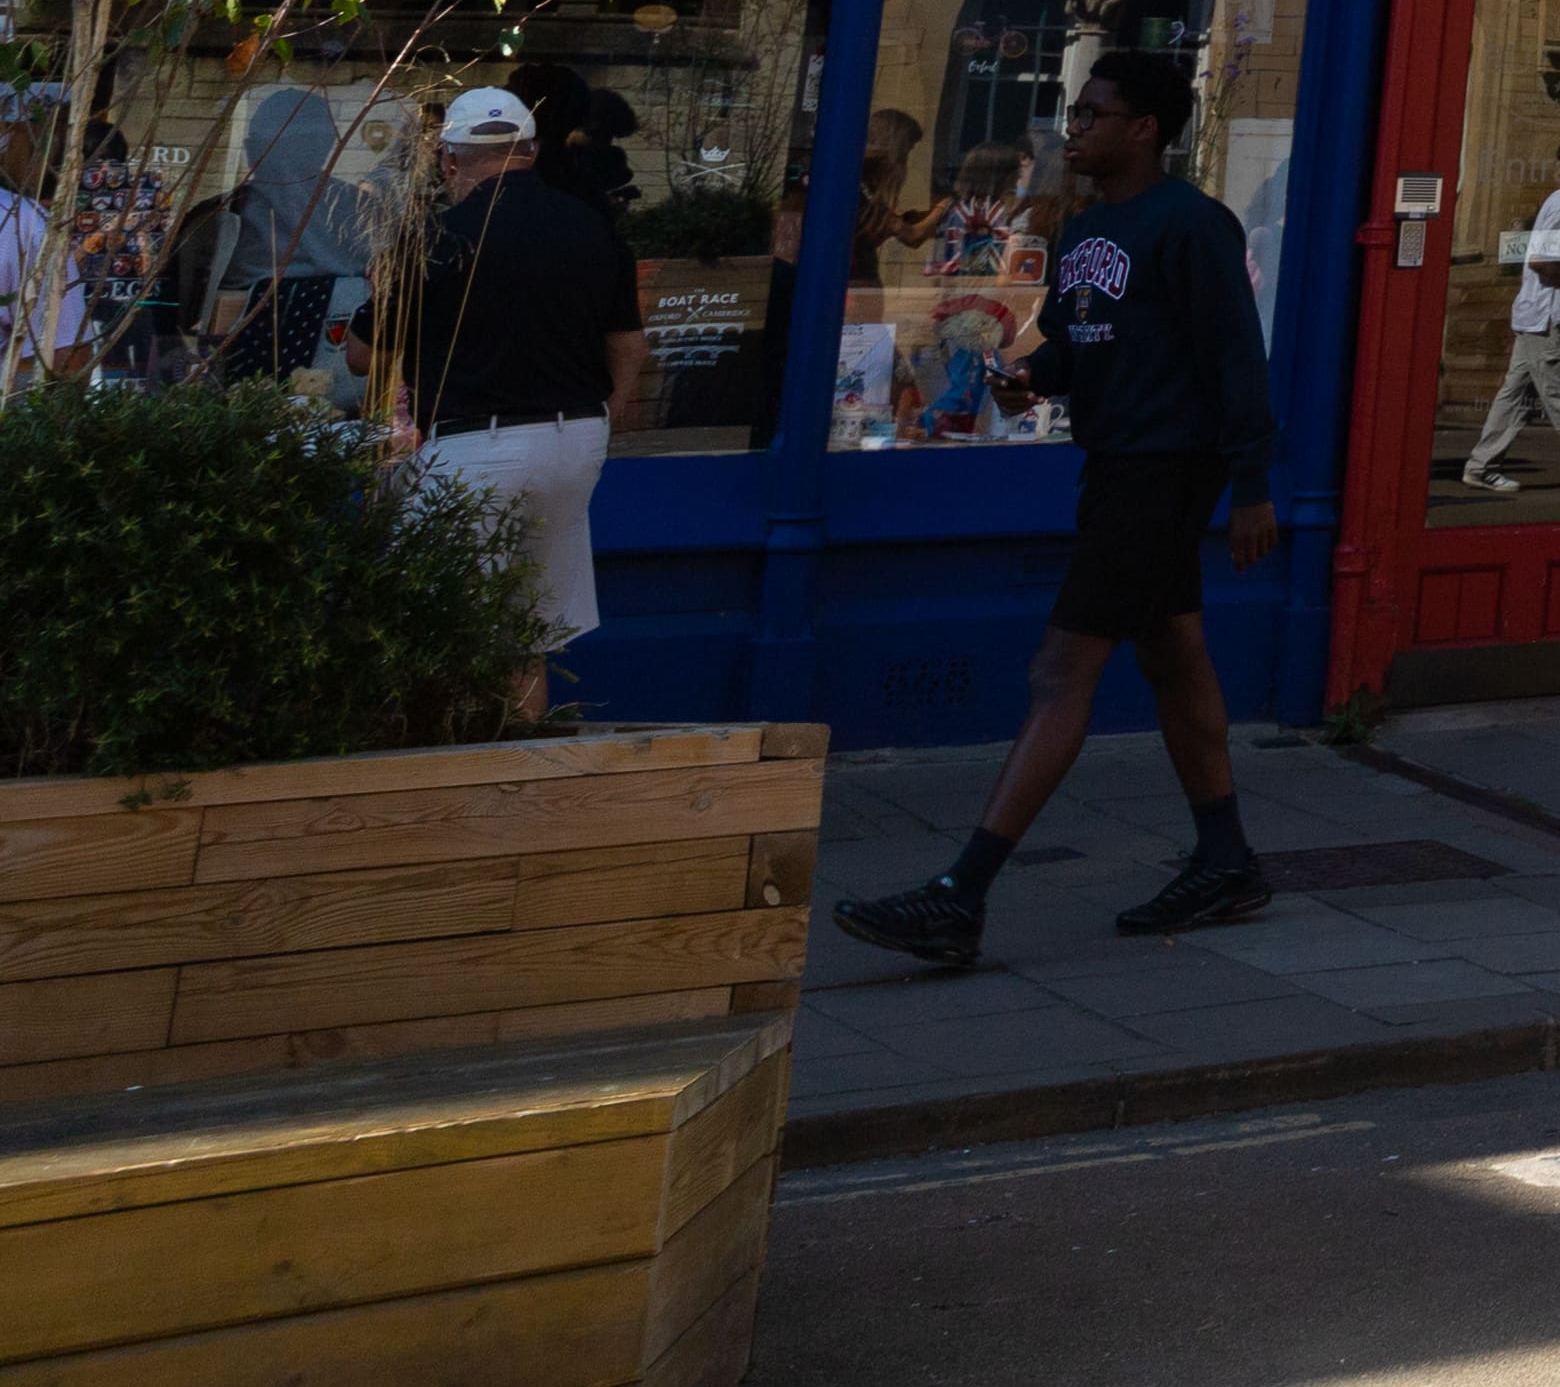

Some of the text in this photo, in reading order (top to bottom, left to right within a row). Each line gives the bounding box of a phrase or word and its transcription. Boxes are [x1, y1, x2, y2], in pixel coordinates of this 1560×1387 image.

[1505, 243, 1528, 255] NO
[658, 293, 740, 308] BOAT RACE
